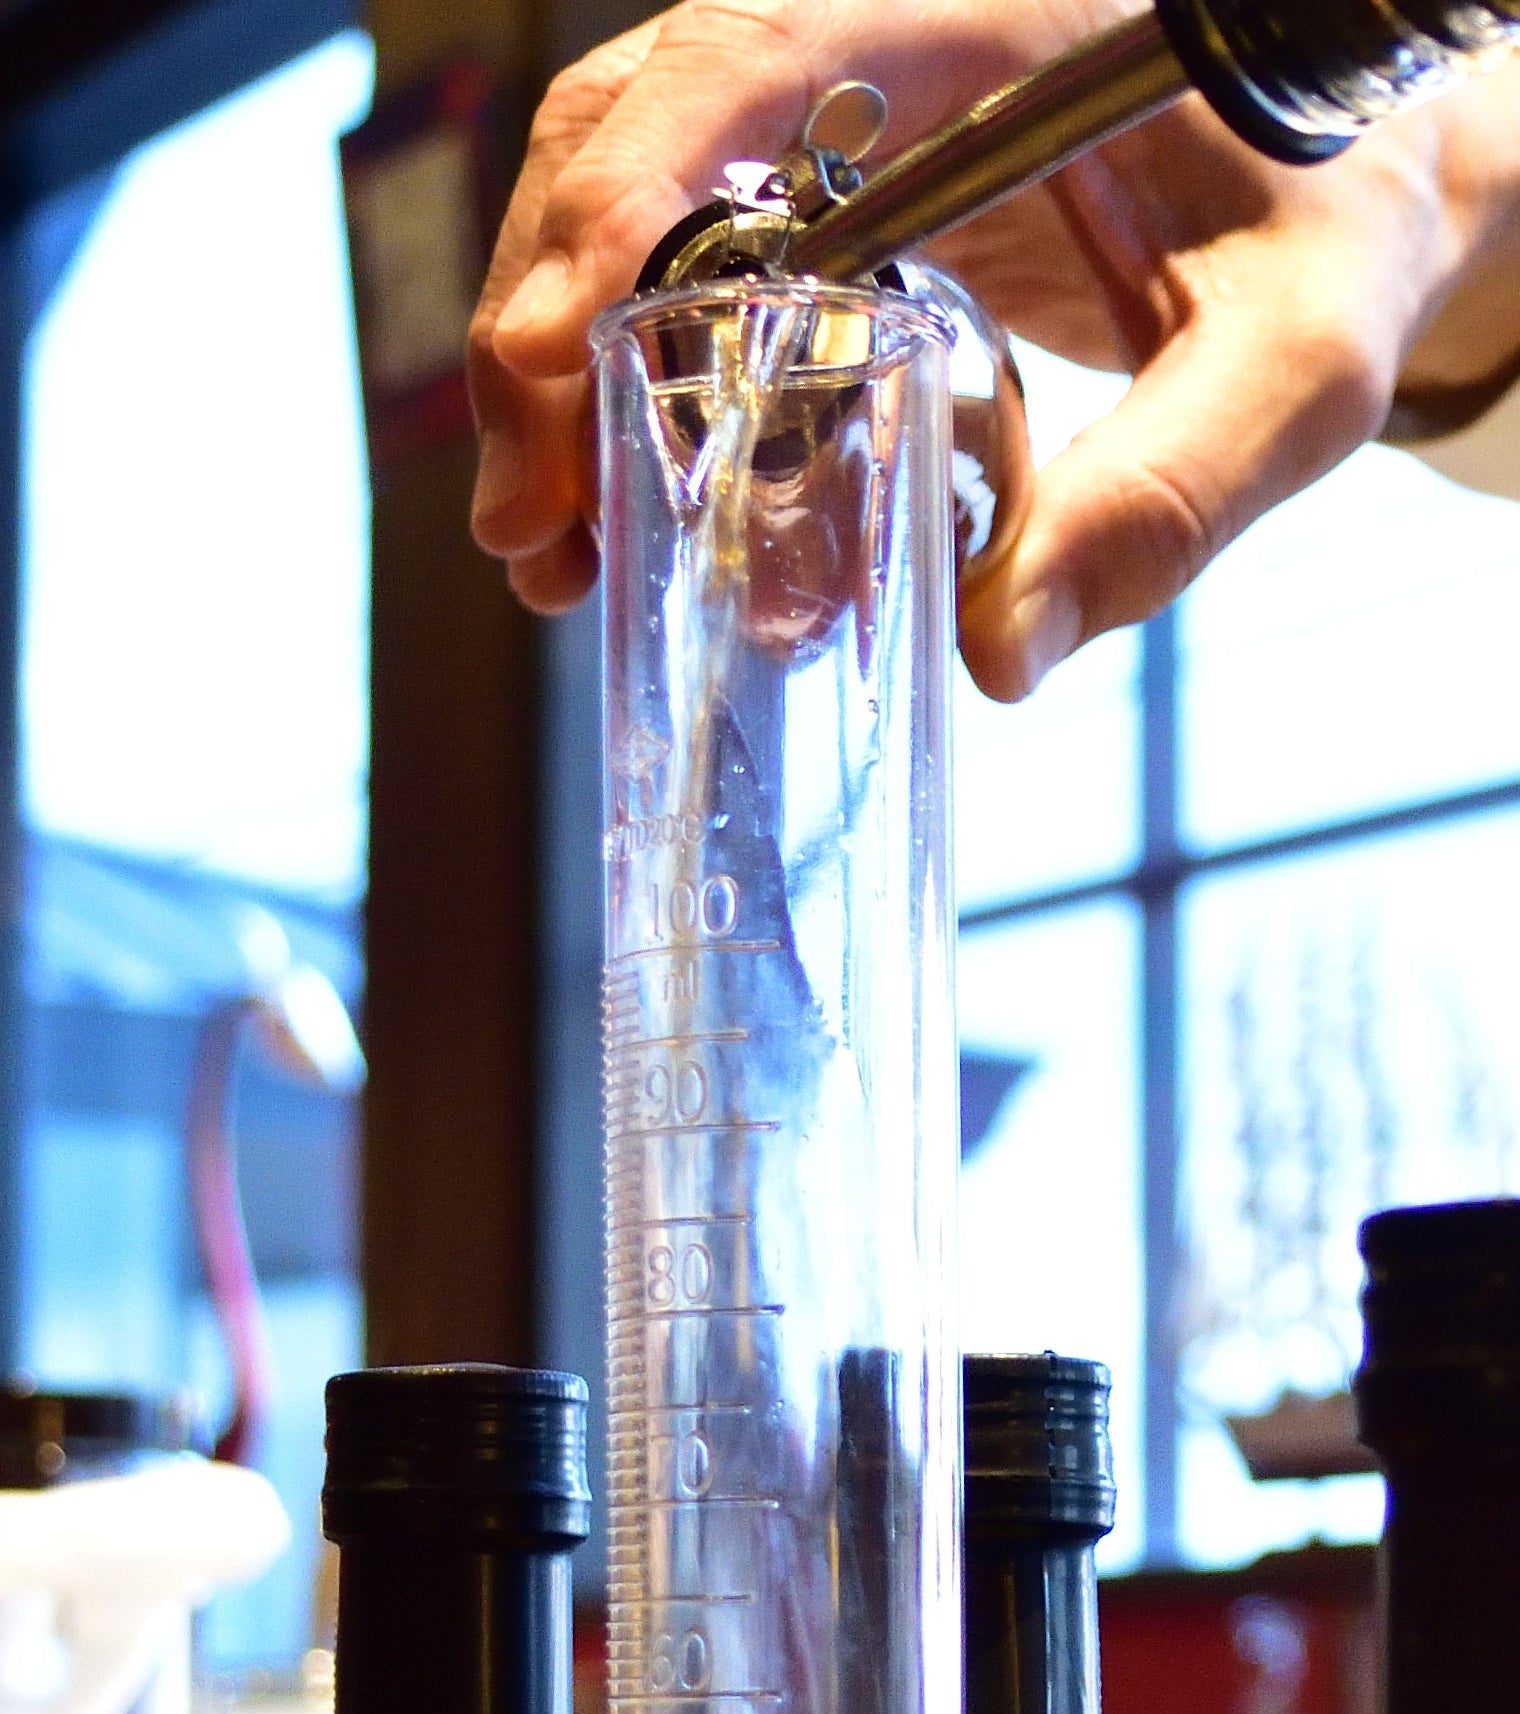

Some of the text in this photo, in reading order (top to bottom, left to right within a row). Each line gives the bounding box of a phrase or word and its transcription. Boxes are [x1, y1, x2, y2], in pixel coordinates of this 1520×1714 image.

[644, 873, 740, 941] 100
[643, 1059, 707, 1126] 90
[647, 1240, 713, 1303] 80
[649, 1629, 712, 1692] 60
